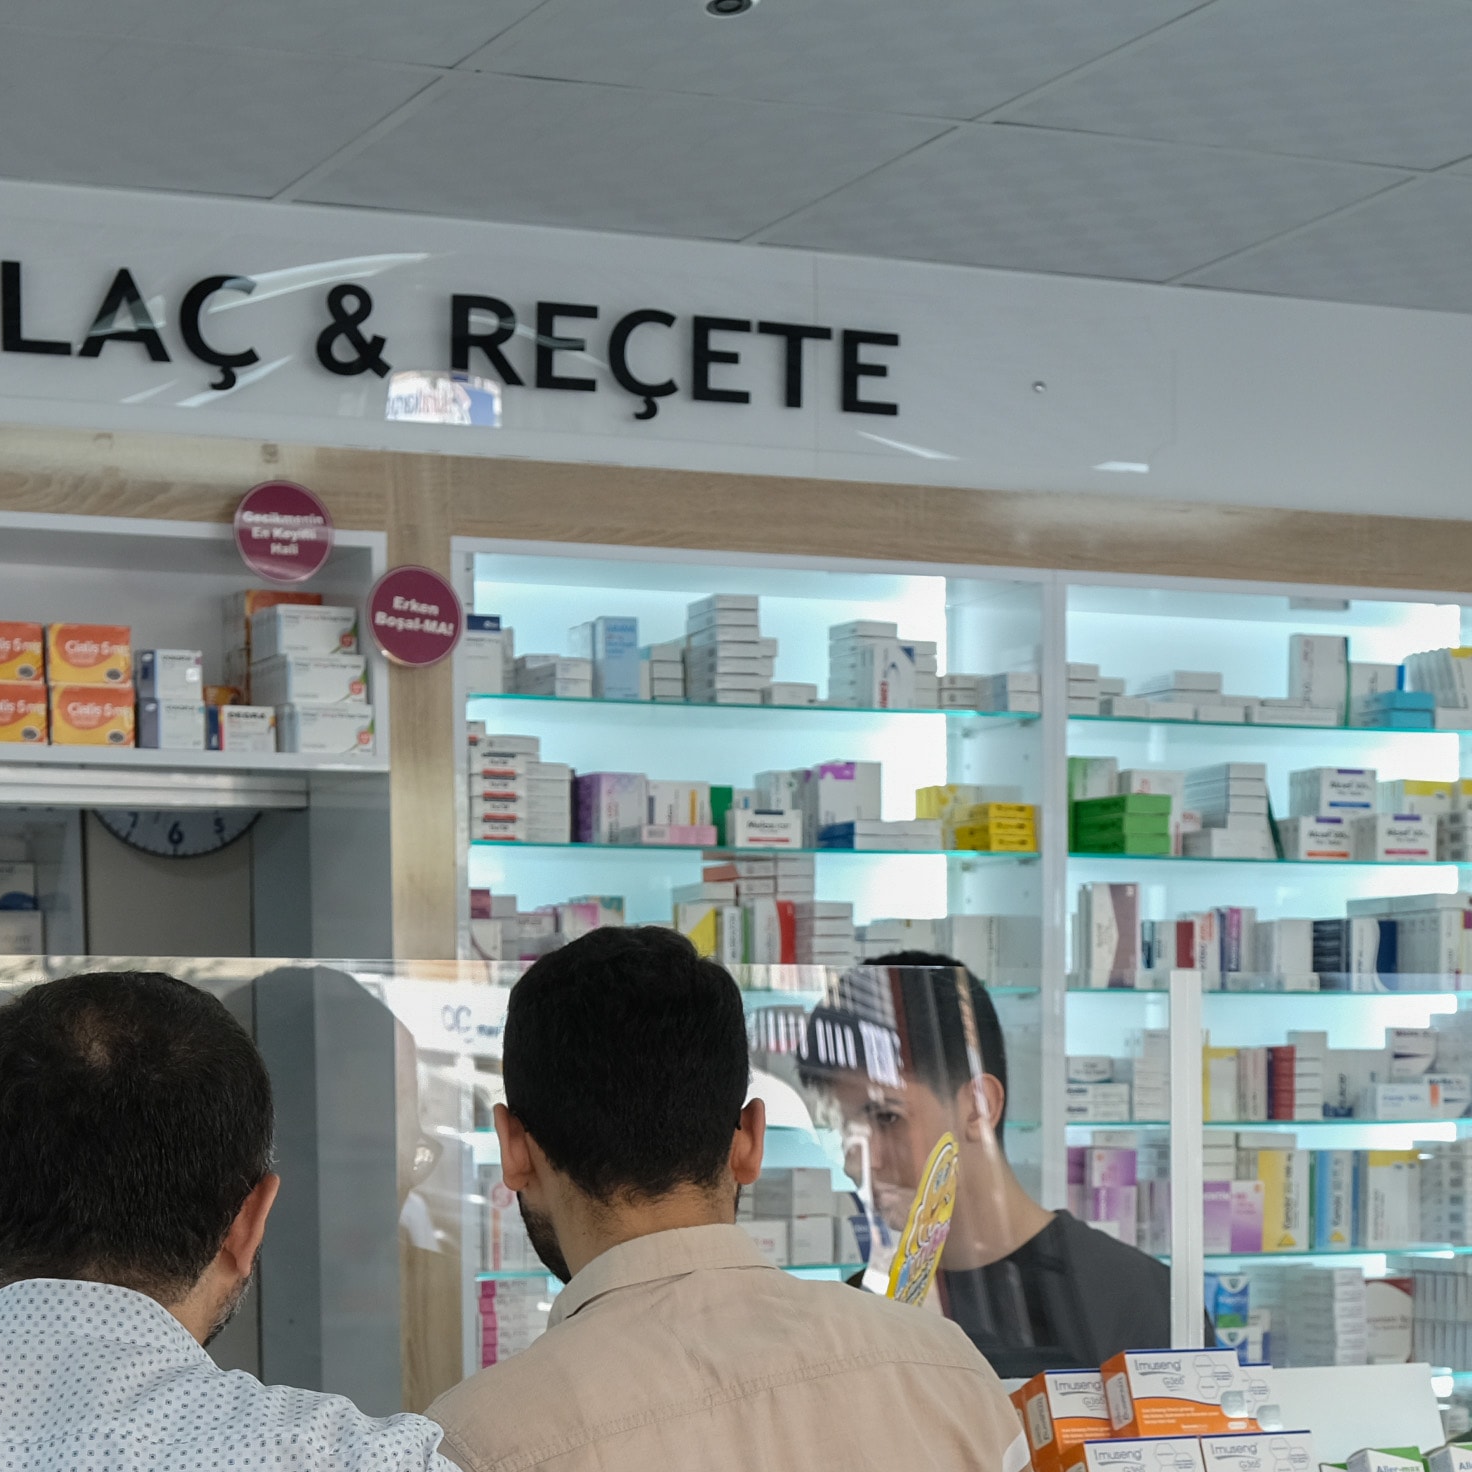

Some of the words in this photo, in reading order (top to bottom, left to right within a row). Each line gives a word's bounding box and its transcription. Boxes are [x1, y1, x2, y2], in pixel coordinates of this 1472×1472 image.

[314, 281, 392, 378] &
[448, 292, 900, 421] REÇETE
[392, 596, 439, 617] Erken
[375, 611, 454, 637] Boşal-MA!
[167, 820, 184, 846] 6
[213, 816, 226, 835] 5
[1134, 1359, 1182, 1372] Imuseng
[1093, 1448, 1143, 1461] Imuseng
[1210, 1443, 1258, 1456] Imuseng
